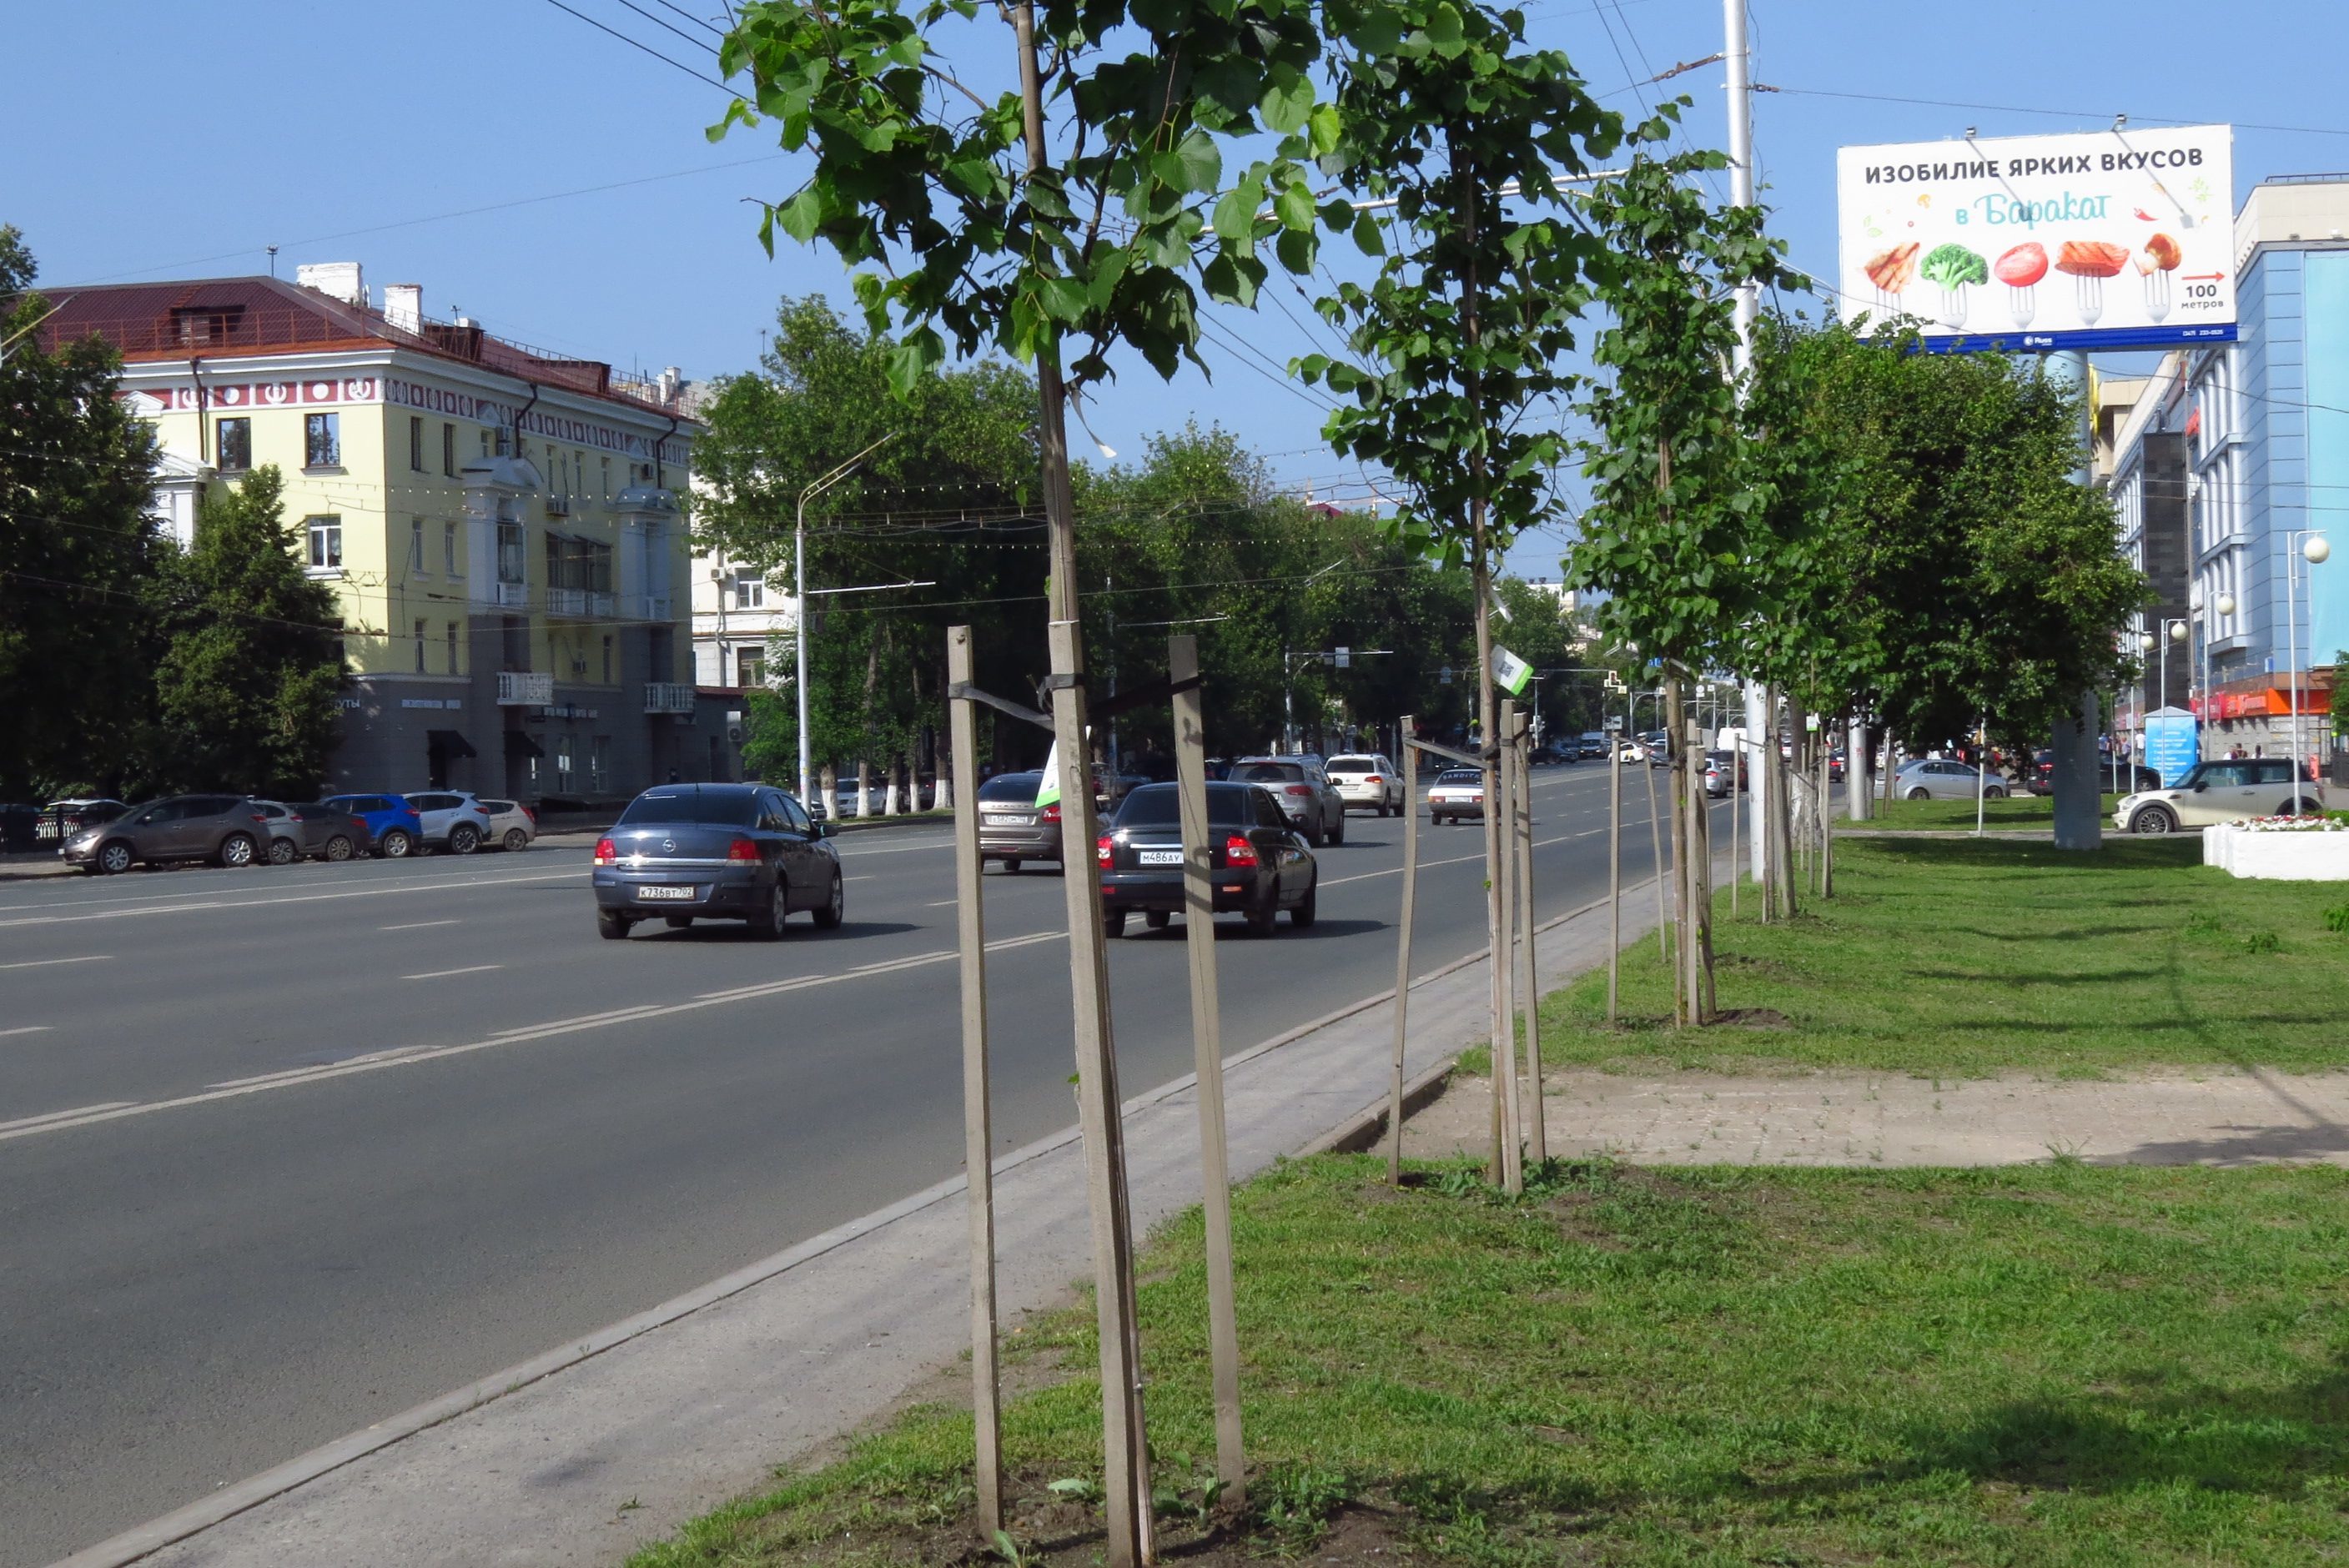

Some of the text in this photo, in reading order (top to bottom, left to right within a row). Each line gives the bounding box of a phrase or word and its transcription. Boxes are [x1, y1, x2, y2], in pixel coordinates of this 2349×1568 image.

[1865, 148, 2203, 183] ИЗОБИЛИЕ ЯРКИХ ВКУСОВ
[1955, 191, 2112, 230] в Баракат
[2186, 284, 2216, 298] 100
[2180, 300, 2224, 310] метров
[1143, 852, 1180, 862] М486АУ
